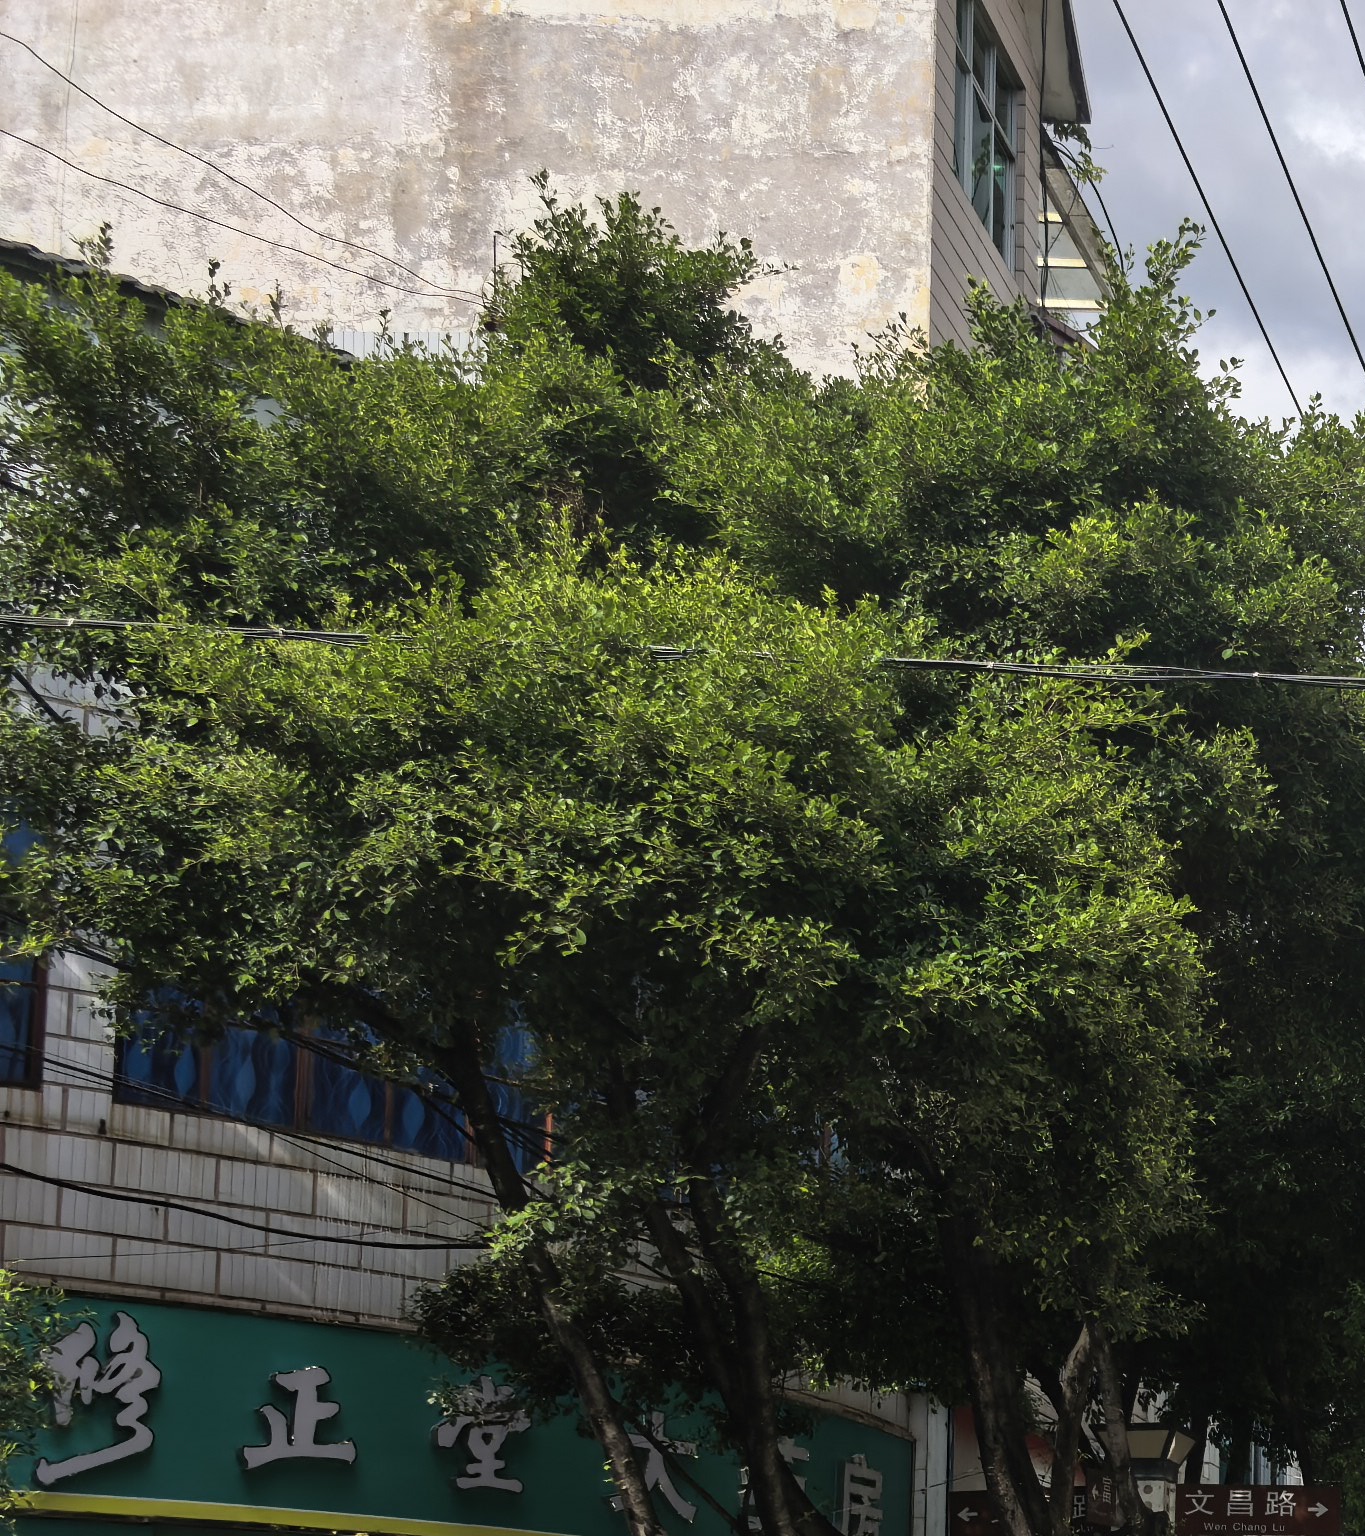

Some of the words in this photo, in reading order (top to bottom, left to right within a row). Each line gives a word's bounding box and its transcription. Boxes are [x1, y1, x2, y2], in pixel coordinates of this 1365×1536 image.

[1185, 1489, 1297, 1517] 文昌路
[1204, 1522, 1227, 1532] Wen
[1232, 1522, 1267, 1533] Chang
[1272, 1522, 1286, 1533] Lu
